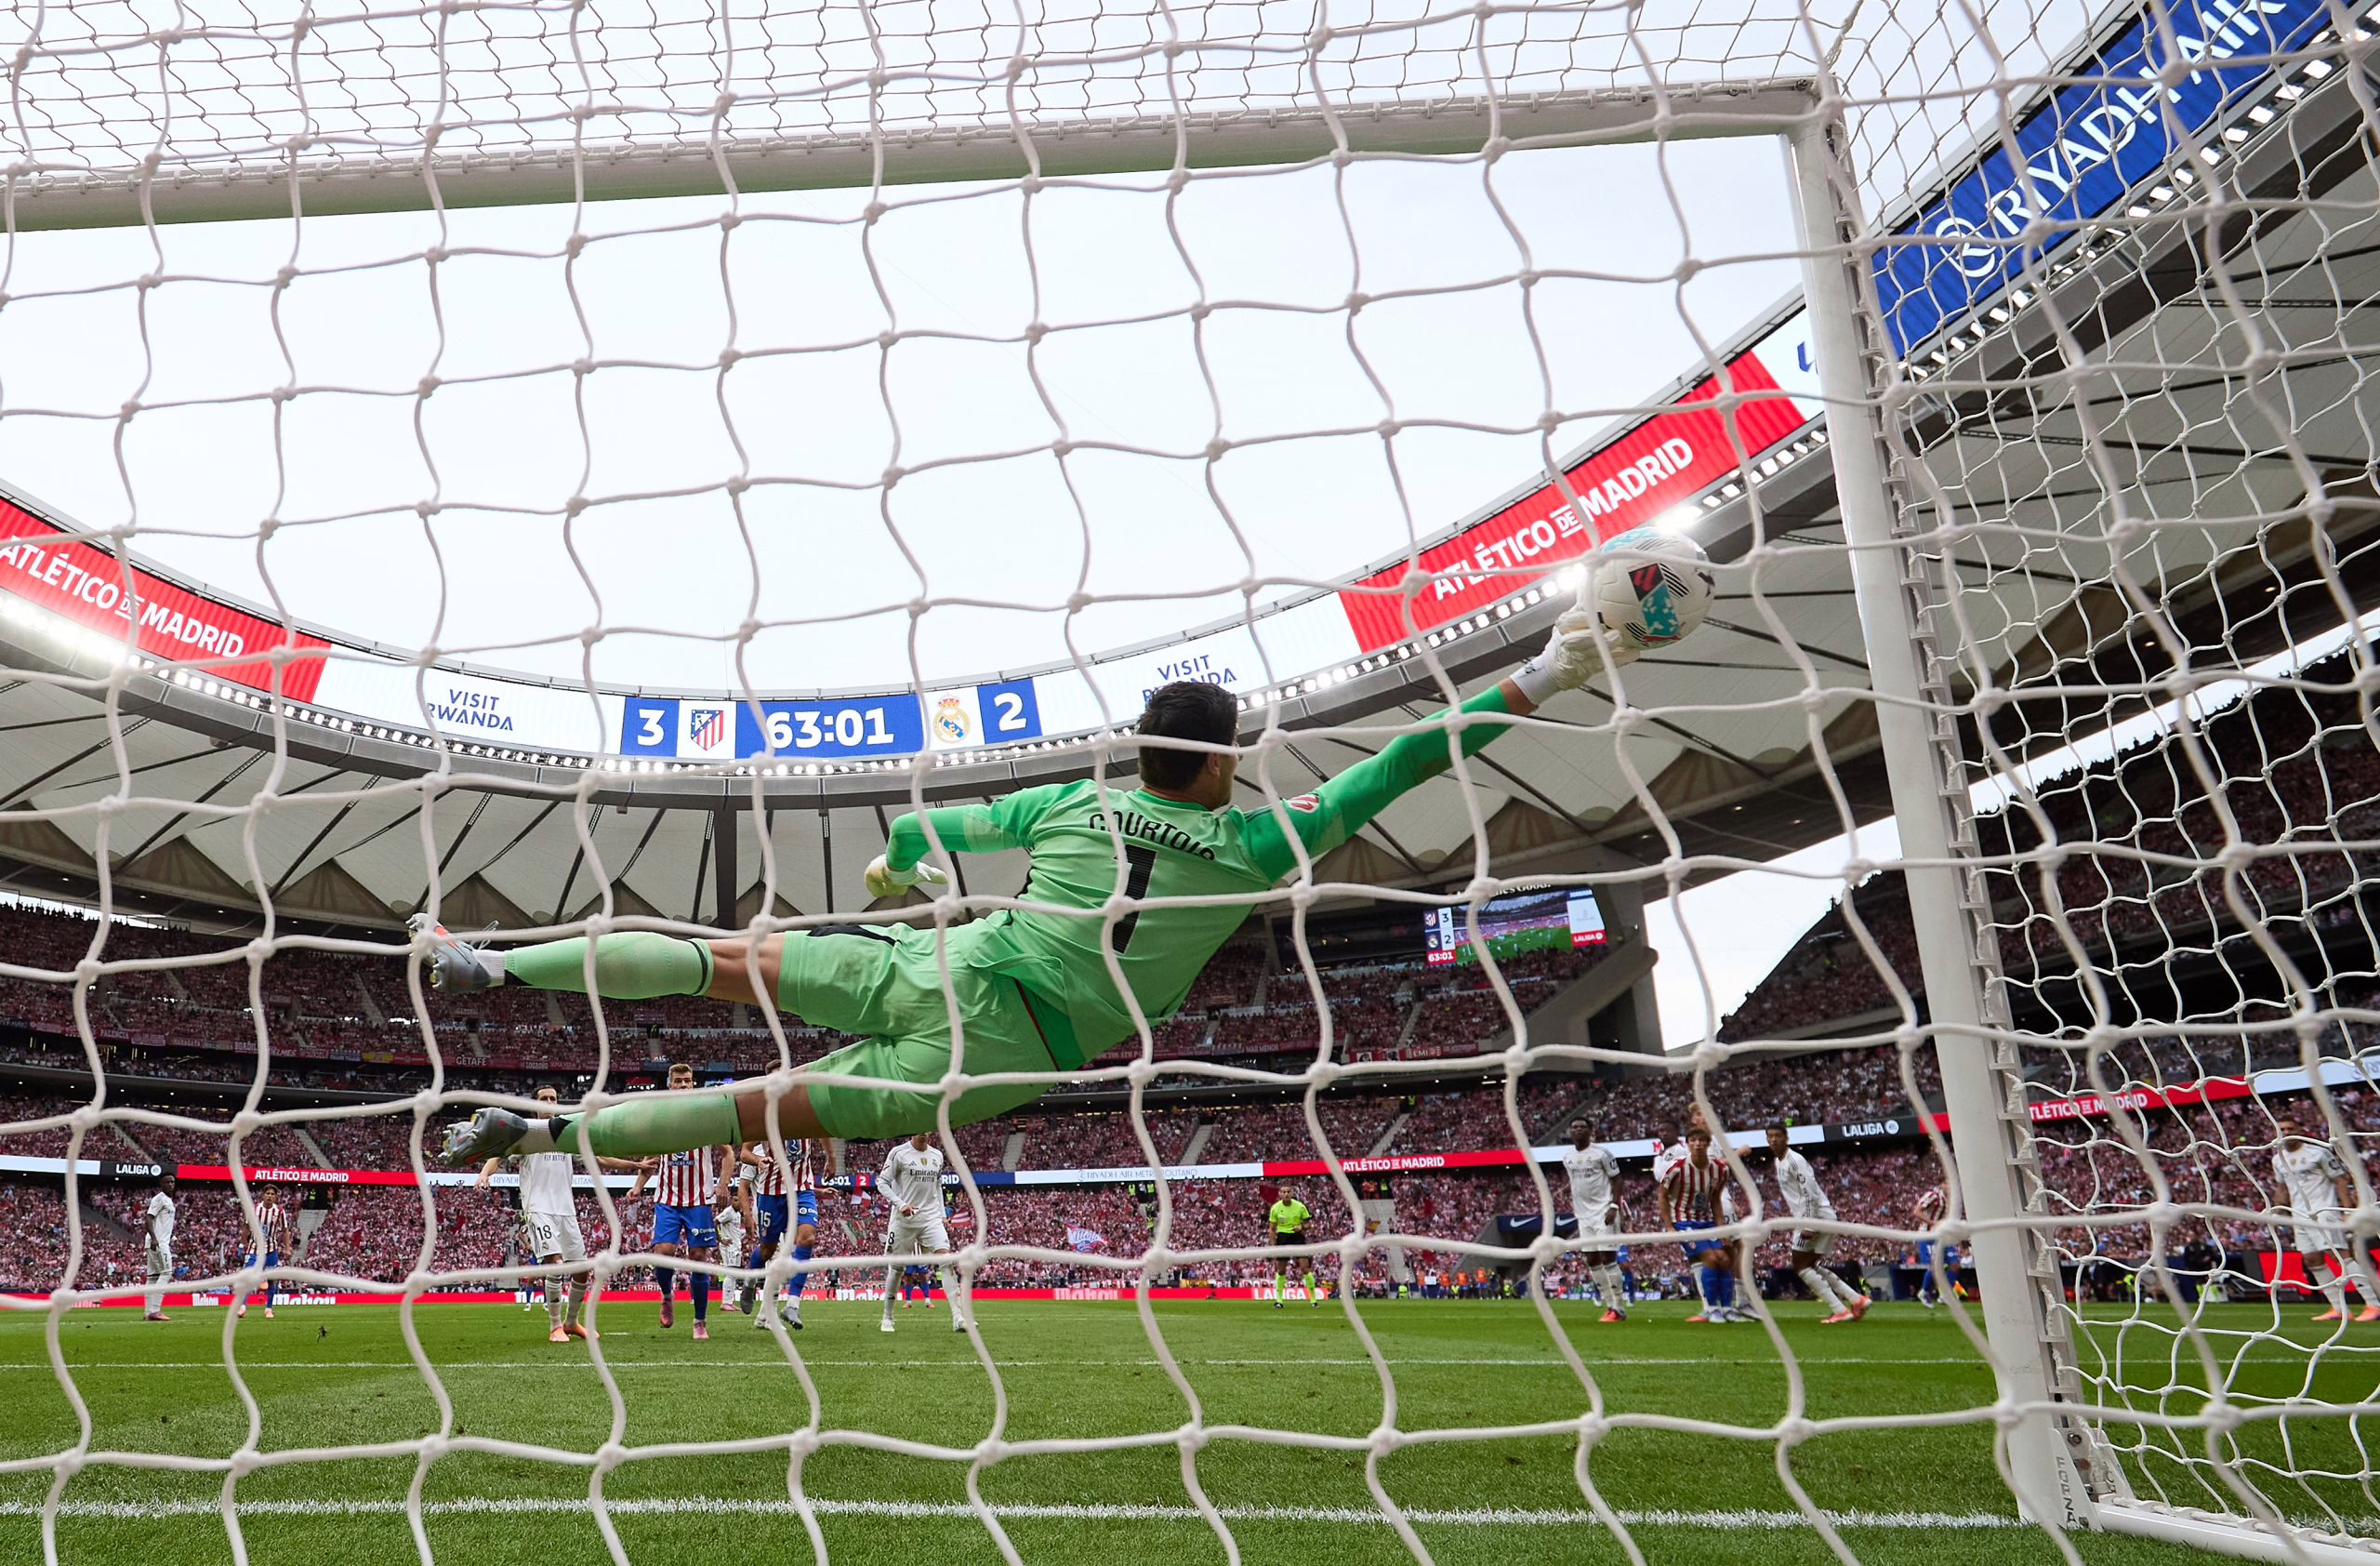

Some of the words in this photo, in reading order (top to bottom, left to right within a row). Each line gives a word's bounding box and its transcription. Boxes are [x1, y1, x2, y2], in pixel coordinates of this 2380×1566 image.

[1985, 66, 2181, 235] RIYADH
[1433, 520, 1555, 600] ATLÉTICO
[1578, 438, 1693, 522] MADRID
[0, 536, 119, 609] ATLÉTICO
[139, 602, 244, 657] MADRID
[1157, 655, 1210, 681] VISIT
[1142, 668, 1237, 701] RNDA
[449, 689, 499, 710] VISIT
[427, 702, 513, 731] RWANDA
[994, 693, 1027, 732] 2
[637, 708, 666, 745] 3
[767, 707, 893, 749] 63:01
[1112, 843, 1158, 955] 1
[1442, 913, 1449, 923] 3
[1444, 935, 1451, 944] 2
[1428, 951, 1454, 962] 63:01
[456, 1055, 487, 1067] GETAFE
[2030, 1102, 2081, 1120] TLÉTICO
[2094, 1094, 2148, 1112] MDRID
[1842, 1122, 1884, 1137] LALIGA
[115, 1163, 150, 1175] LALIGA
[910, 1168, 938, 1176] Emirate
[1343, 1158, 1391, 1172] ATLÉTICO
[1401, 1157, 1445, 1169] MADRID
[255, 1168, 299, 1180] ATLÉTICO
[310, 1172, 350, 1182] MADRID
[859, 1175, 866, 1186] 2
[1135, 1169, 1197, 1177] METROLITANO
[760, 1210, 771, 1228] 15
[536, 1225, 552, 1241] 18
[888, 1231, 895, 1245] 8
[163, 1254, 168, 1263] 7
[272, 1294, 337, 1306] Mahou
[1255, 1288, 1306, 1300] LAGA
